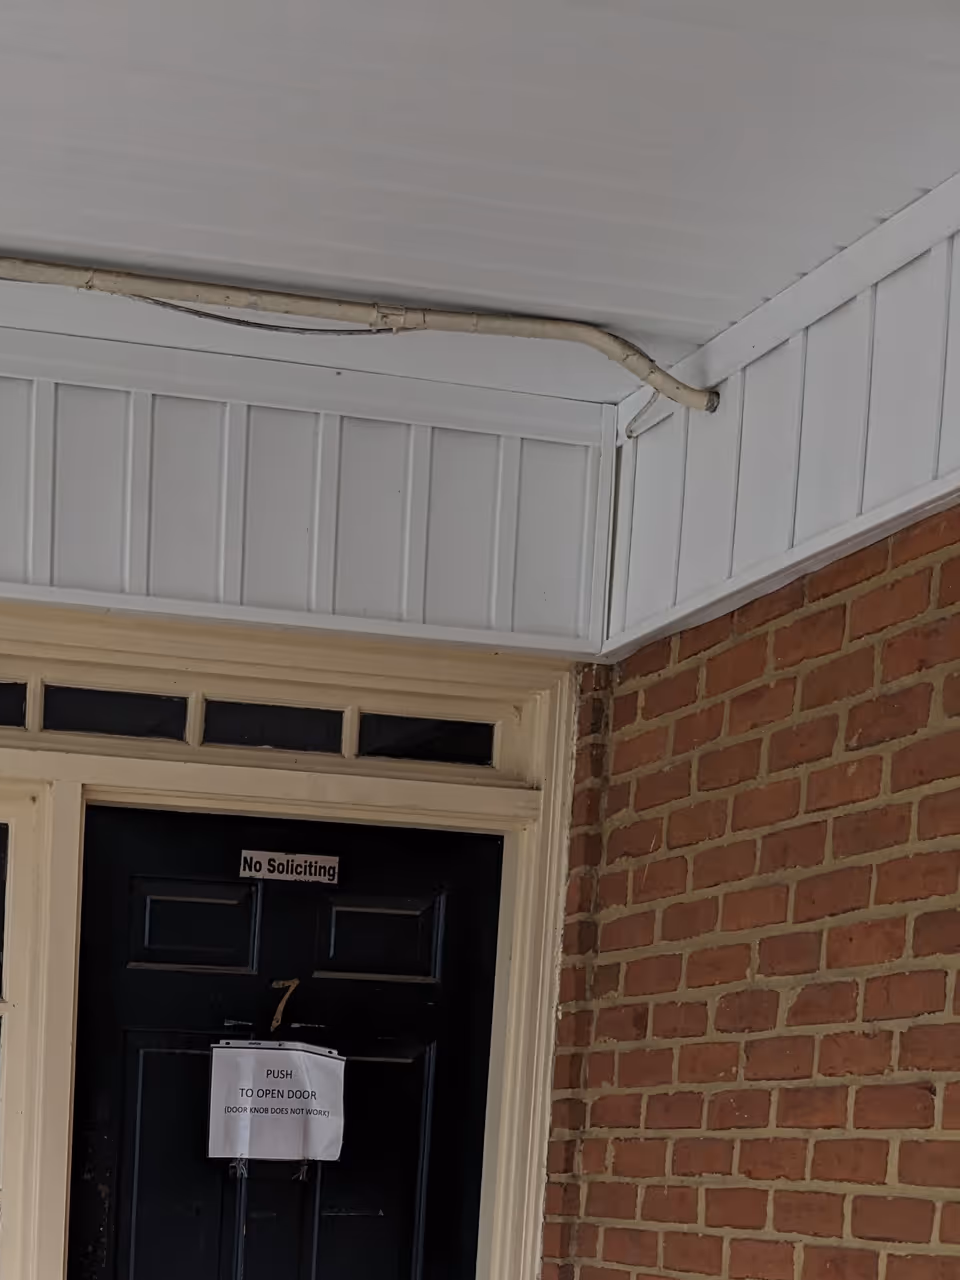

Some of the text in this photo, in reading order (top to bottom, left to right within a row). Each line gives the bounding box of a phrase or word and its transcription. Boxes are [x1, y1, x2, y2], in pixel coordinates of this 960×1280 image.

[242, 856, 336, 881] No Soliciting
[271, 979, 300, 1031] 7
[266, 1069, 293, 1079] PUSH
[239, 1088, 317, 1100] TO OPEN DOOR
[249, 1107, 269, 1115] KNOB
[270, 1107, 289, 1115] DOES
